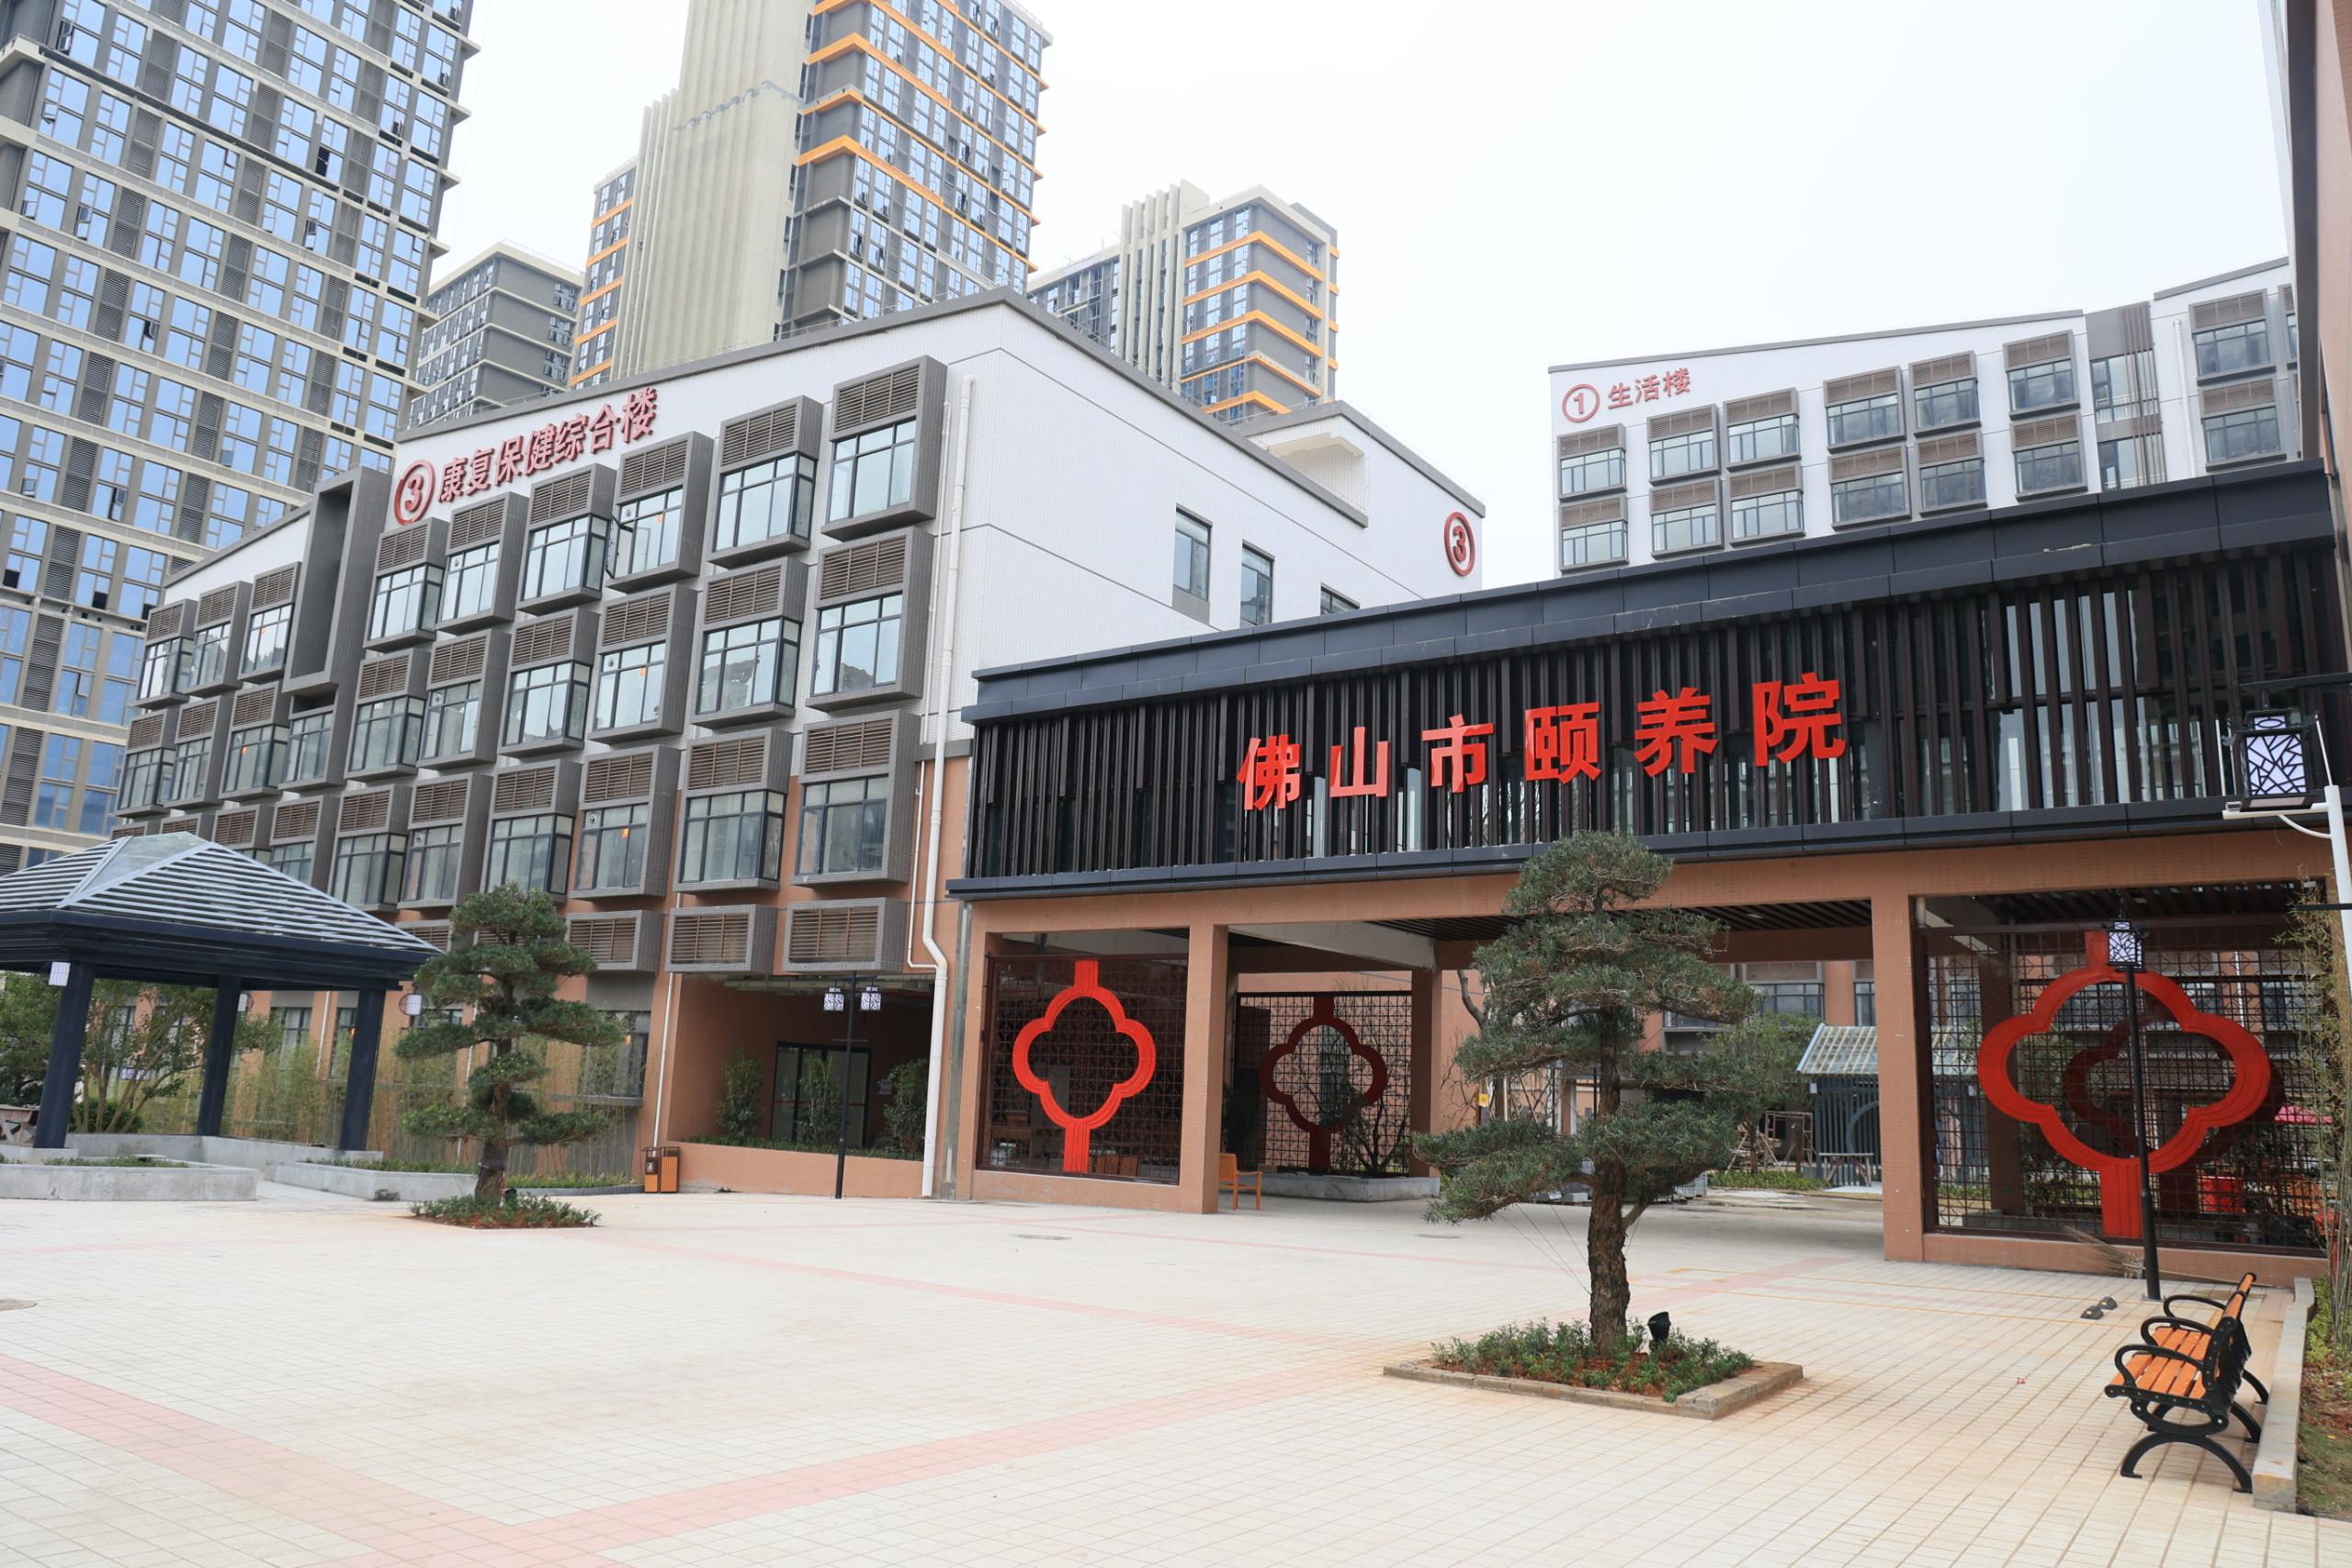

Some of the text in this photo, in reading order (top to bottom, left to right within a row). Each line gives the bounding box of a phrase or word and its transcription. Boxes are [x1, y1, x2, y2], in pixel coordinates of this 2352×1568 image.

[437, 387, 659, 503] 康复保健综合楼
[1608, 367, 1690, 410] 生活楼
[1237, 671, 1847, 811] 佛山市颐养院
